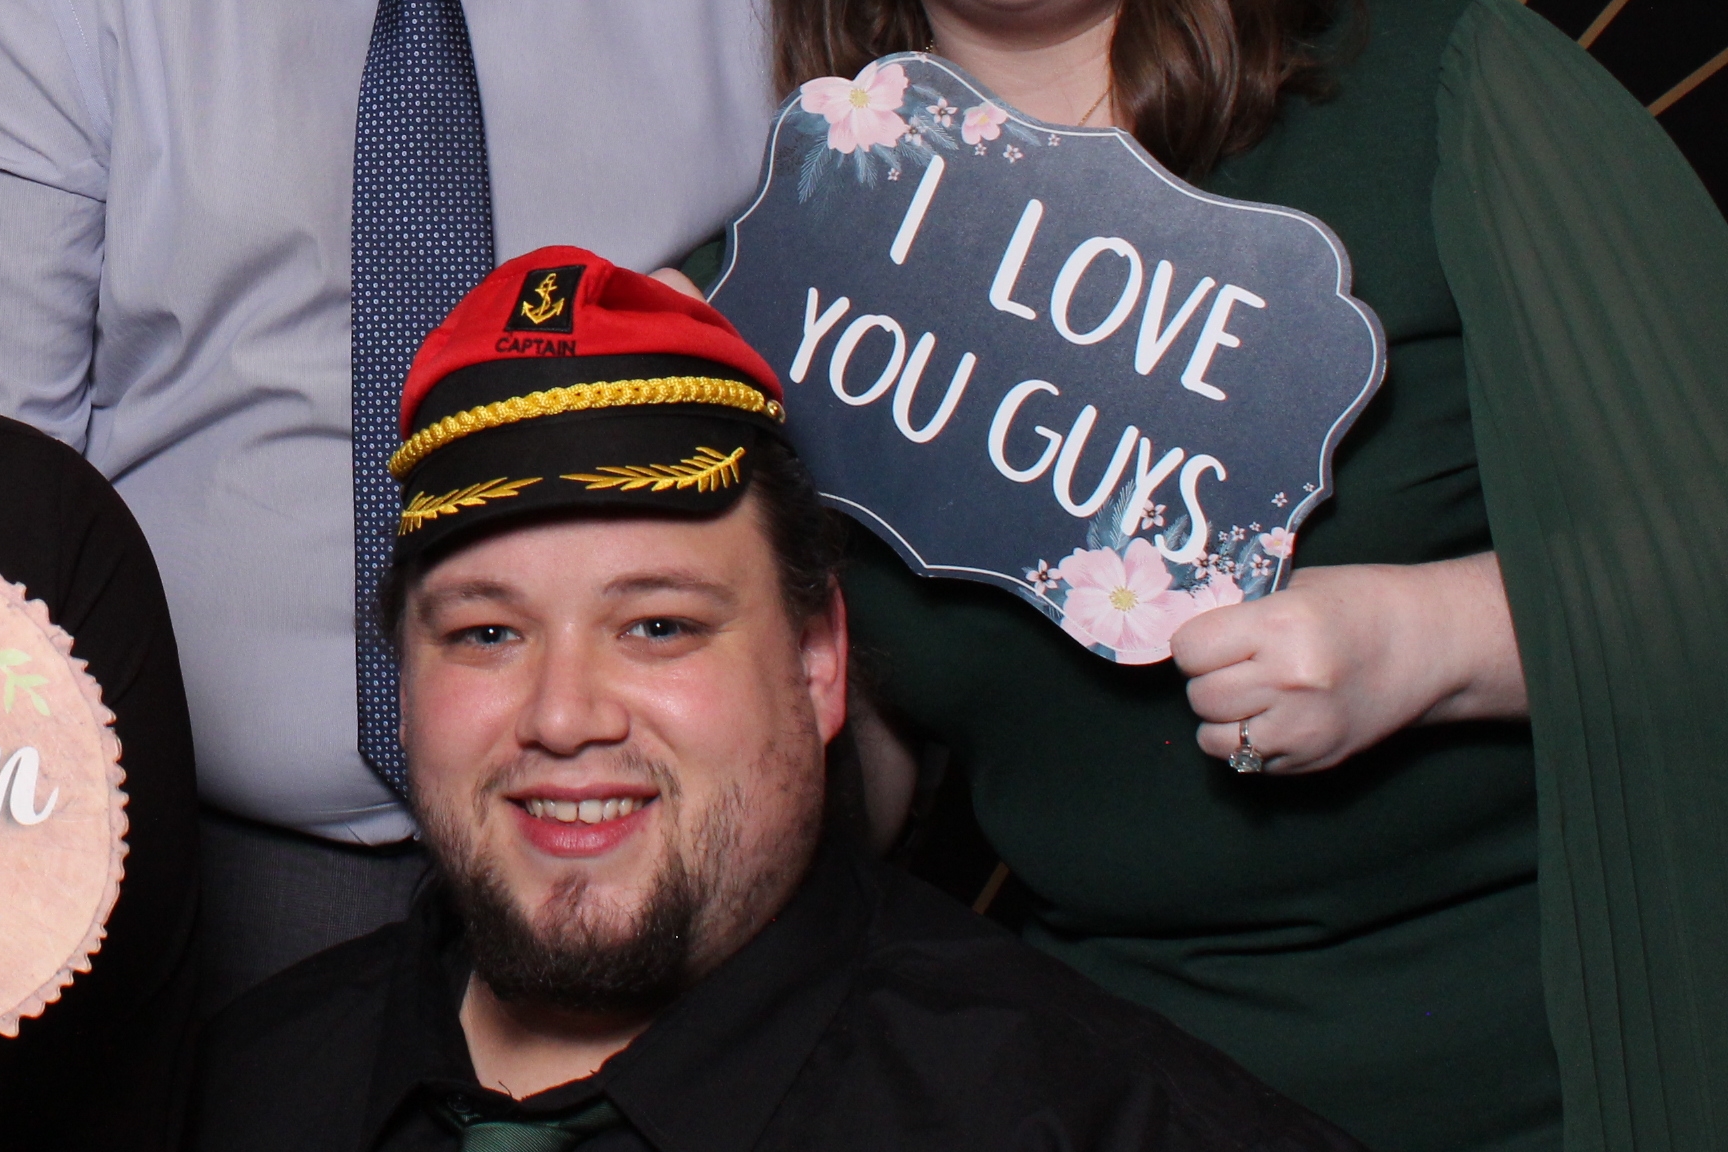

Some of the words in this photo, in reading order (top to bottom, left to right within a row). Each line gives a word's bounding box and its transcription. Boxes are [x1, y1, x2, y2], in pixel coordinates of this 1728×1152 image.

[495, 336, 577, 357] CAPTAIN
[889, 155, 944, 265] I
[989, 199, 1265, 400] LOVE
[790, 287, 976, 443] YOU
[988, 379, 1226, 564] GUYS
